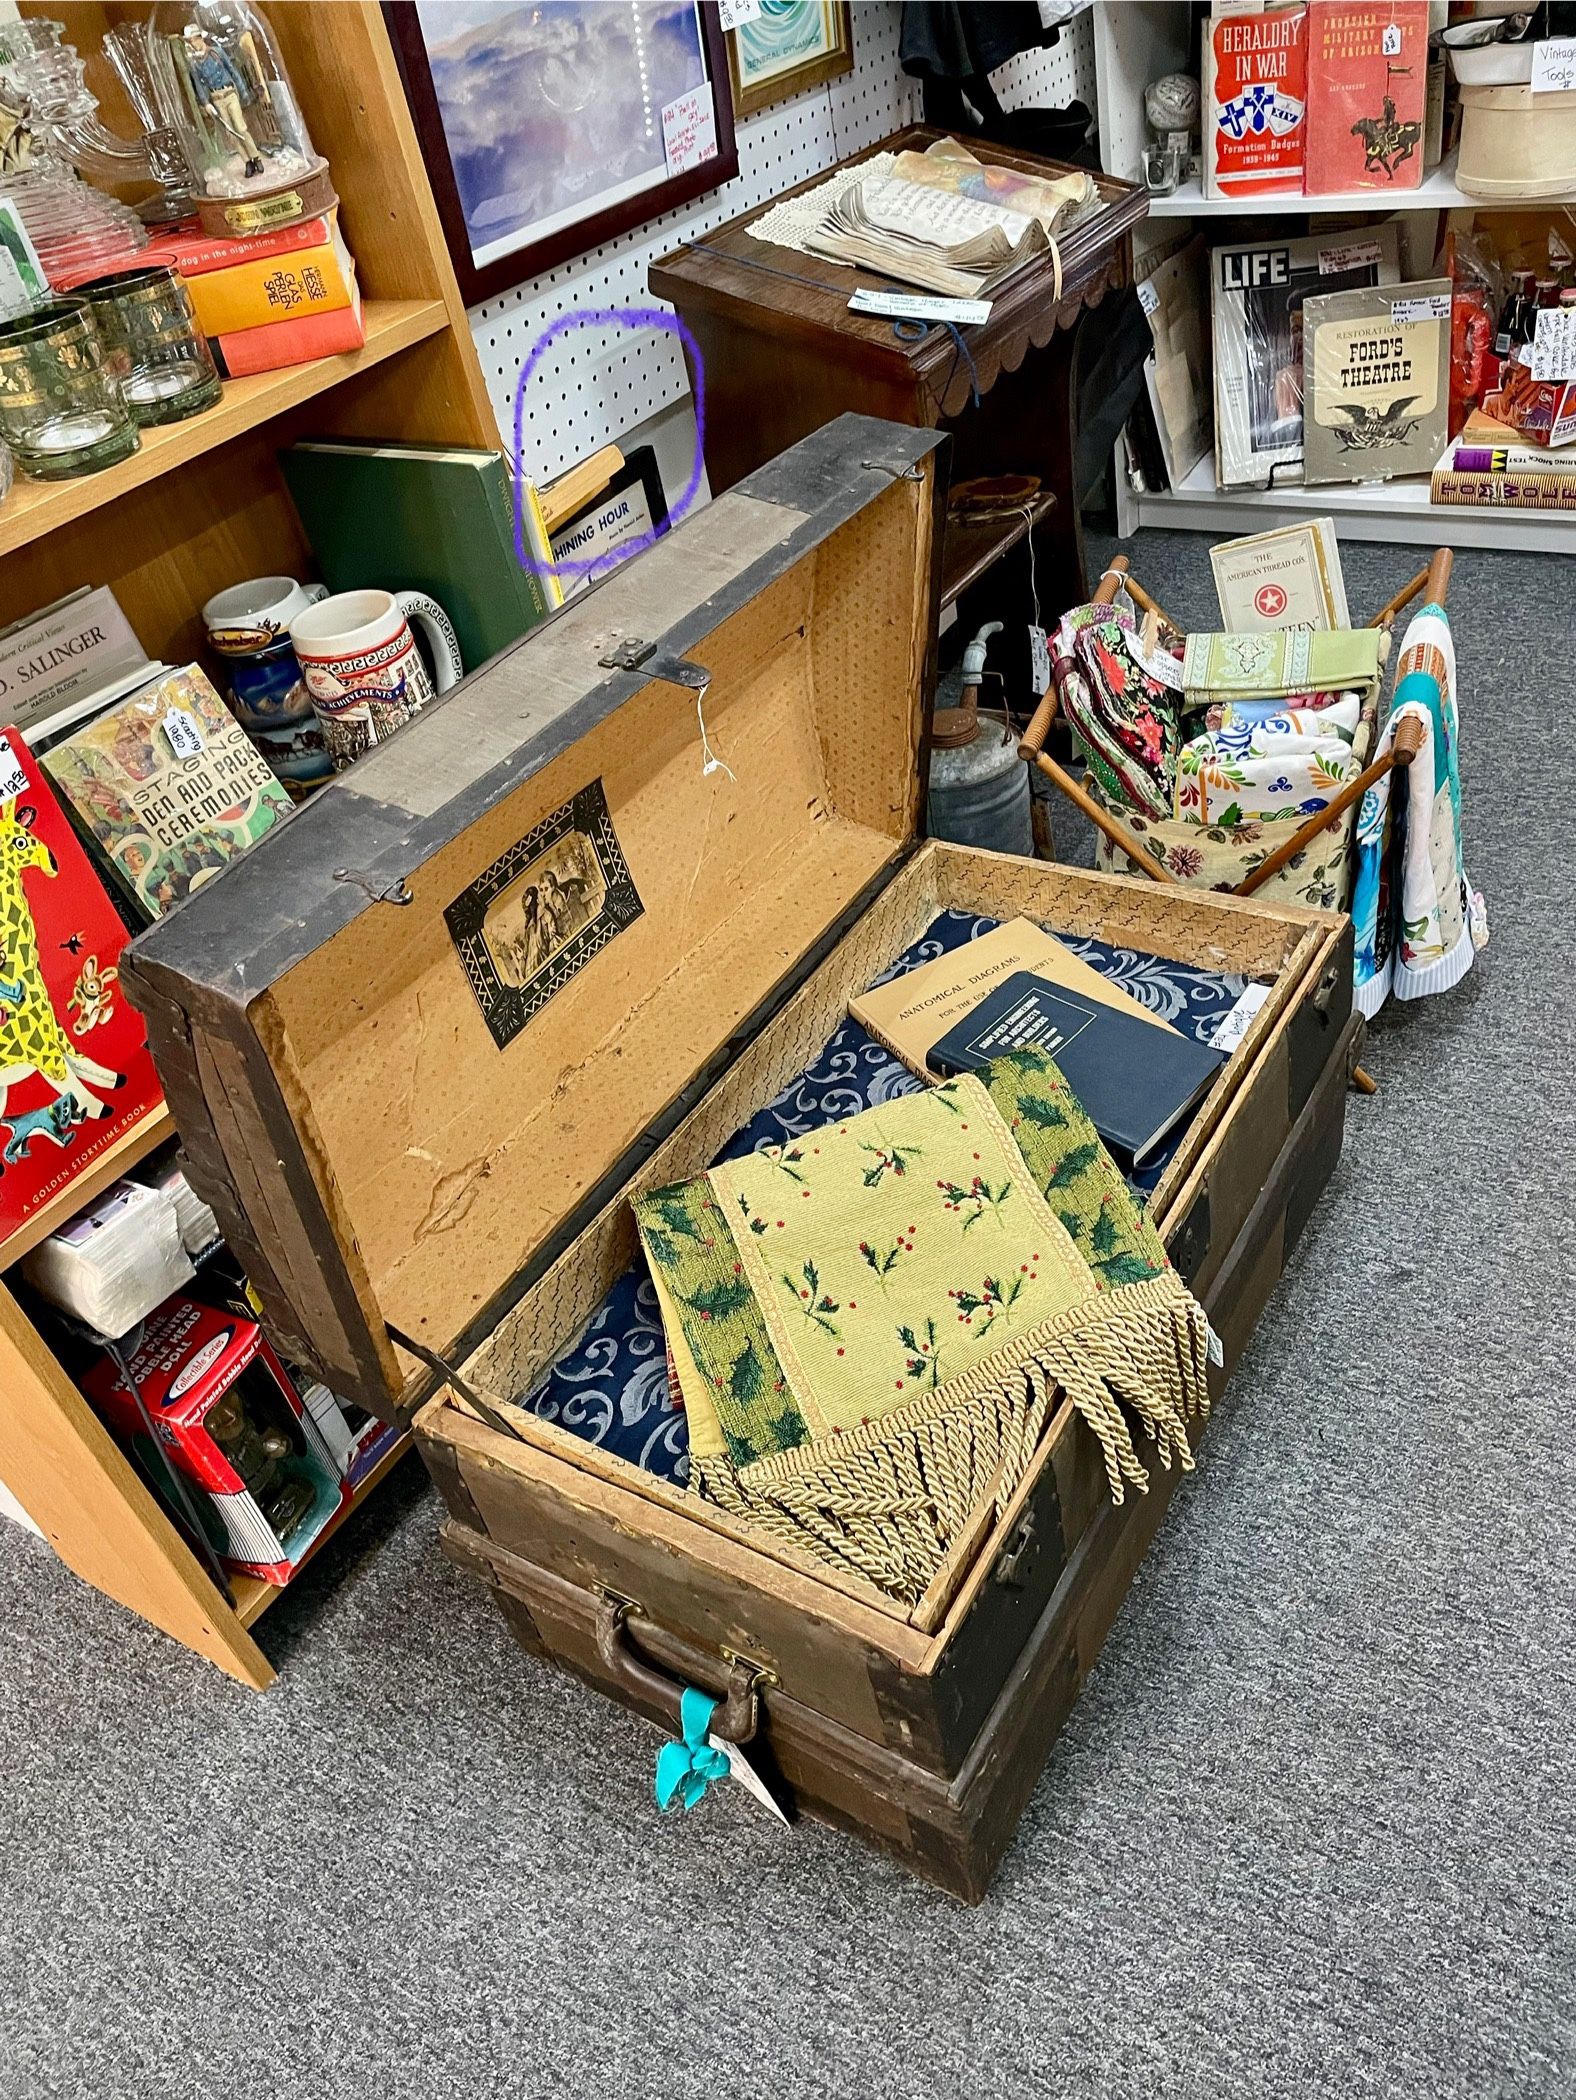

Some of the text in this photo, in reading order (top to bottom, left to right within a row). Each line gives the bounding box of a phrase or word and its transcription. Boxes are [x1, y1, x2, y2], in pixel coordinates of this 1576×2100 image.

[1223, 19, 1301, 53] HERALDRY
[1323, 29, 1375, 45] MILITARY
[747, 36, 820, 69] GENERAL DYNAMICS
[1235, 52, 1287, 81] IN WAR
[1322, 44, 1380, 60] OF ARIZON
[1541, 66, 1574, 81] Tools
[1273, 109, 1295, 122] XIV
[1223, 139, 1300, 155] Formation Badges
[181, 238, 276, 266] dog in the night-time
[304, 267, 323, 301] HESSE
[1224, 251, 1288, 288] LIFE
[263, 281, 280, 306] SPIEL
[271, 272, 294, 310] PERLEN
[284, 273, 302, 304] GLAS
[297, 280, 306, 293] DAS
[1336, 322, 1417, 341] RESTORATION OF
[1349, 337, 1403, 363] FORD'S
[1341, 361, 1412, 389] THEATRE
[1528, 455, 1553, 466] SHOCK
[598, 501, 630, 532] HOUR
[1226, 568, 1262, 583] AMERICAN
[1262, 560, 1291, 574] THREAD
[1254, 553, 1273, 563] THE
[17, 626, 107, 684] SALINGER
[18, 633, 44, 653] Critical
[31, 679, 79, 709] HAROLD BLOOM
[328, 689, 393, 710] ACHIEVEMENTS
[168, 724, 185, 749] 1980
[133, 729, 245, 806] STAGING
[141, 742, 259, 827] DEN AND PACK
[157, 762, 272, 847] CEREMONIES
[899, 955, 1021, 1020] ANATOMICAL DIAGRAMS
[938, 1007, 955, 1020] FOR
[957, 999, 973, 1010] THE
[973, 991, 987, 1001] USE
[1026, 957, 1054, 974] UDENTS
[997, 1035, 1012, 1046] FOR
[1009, 1009, 1041, 1038] ARCHITECTS
[864, 1021, 909, 1067] ANATOMICAL
[22, 1103, 147, 1214] A GOLDEN STORYTIME BOOK
[146, 1303, 193, 1352] PAINTED
[125, 1311, 201, 1392] OBBLE HEAD
[160, 1340, 193, 1373] DOLL
[175, 1339, 225, 1392] Collectible Series
[183, 1409, 202, 1428] Hand
[200, 1384, 223, 1410] Painted
[221, 1363, 242, 1387] Bobble
[240, 1346, 256, 1365] Head
